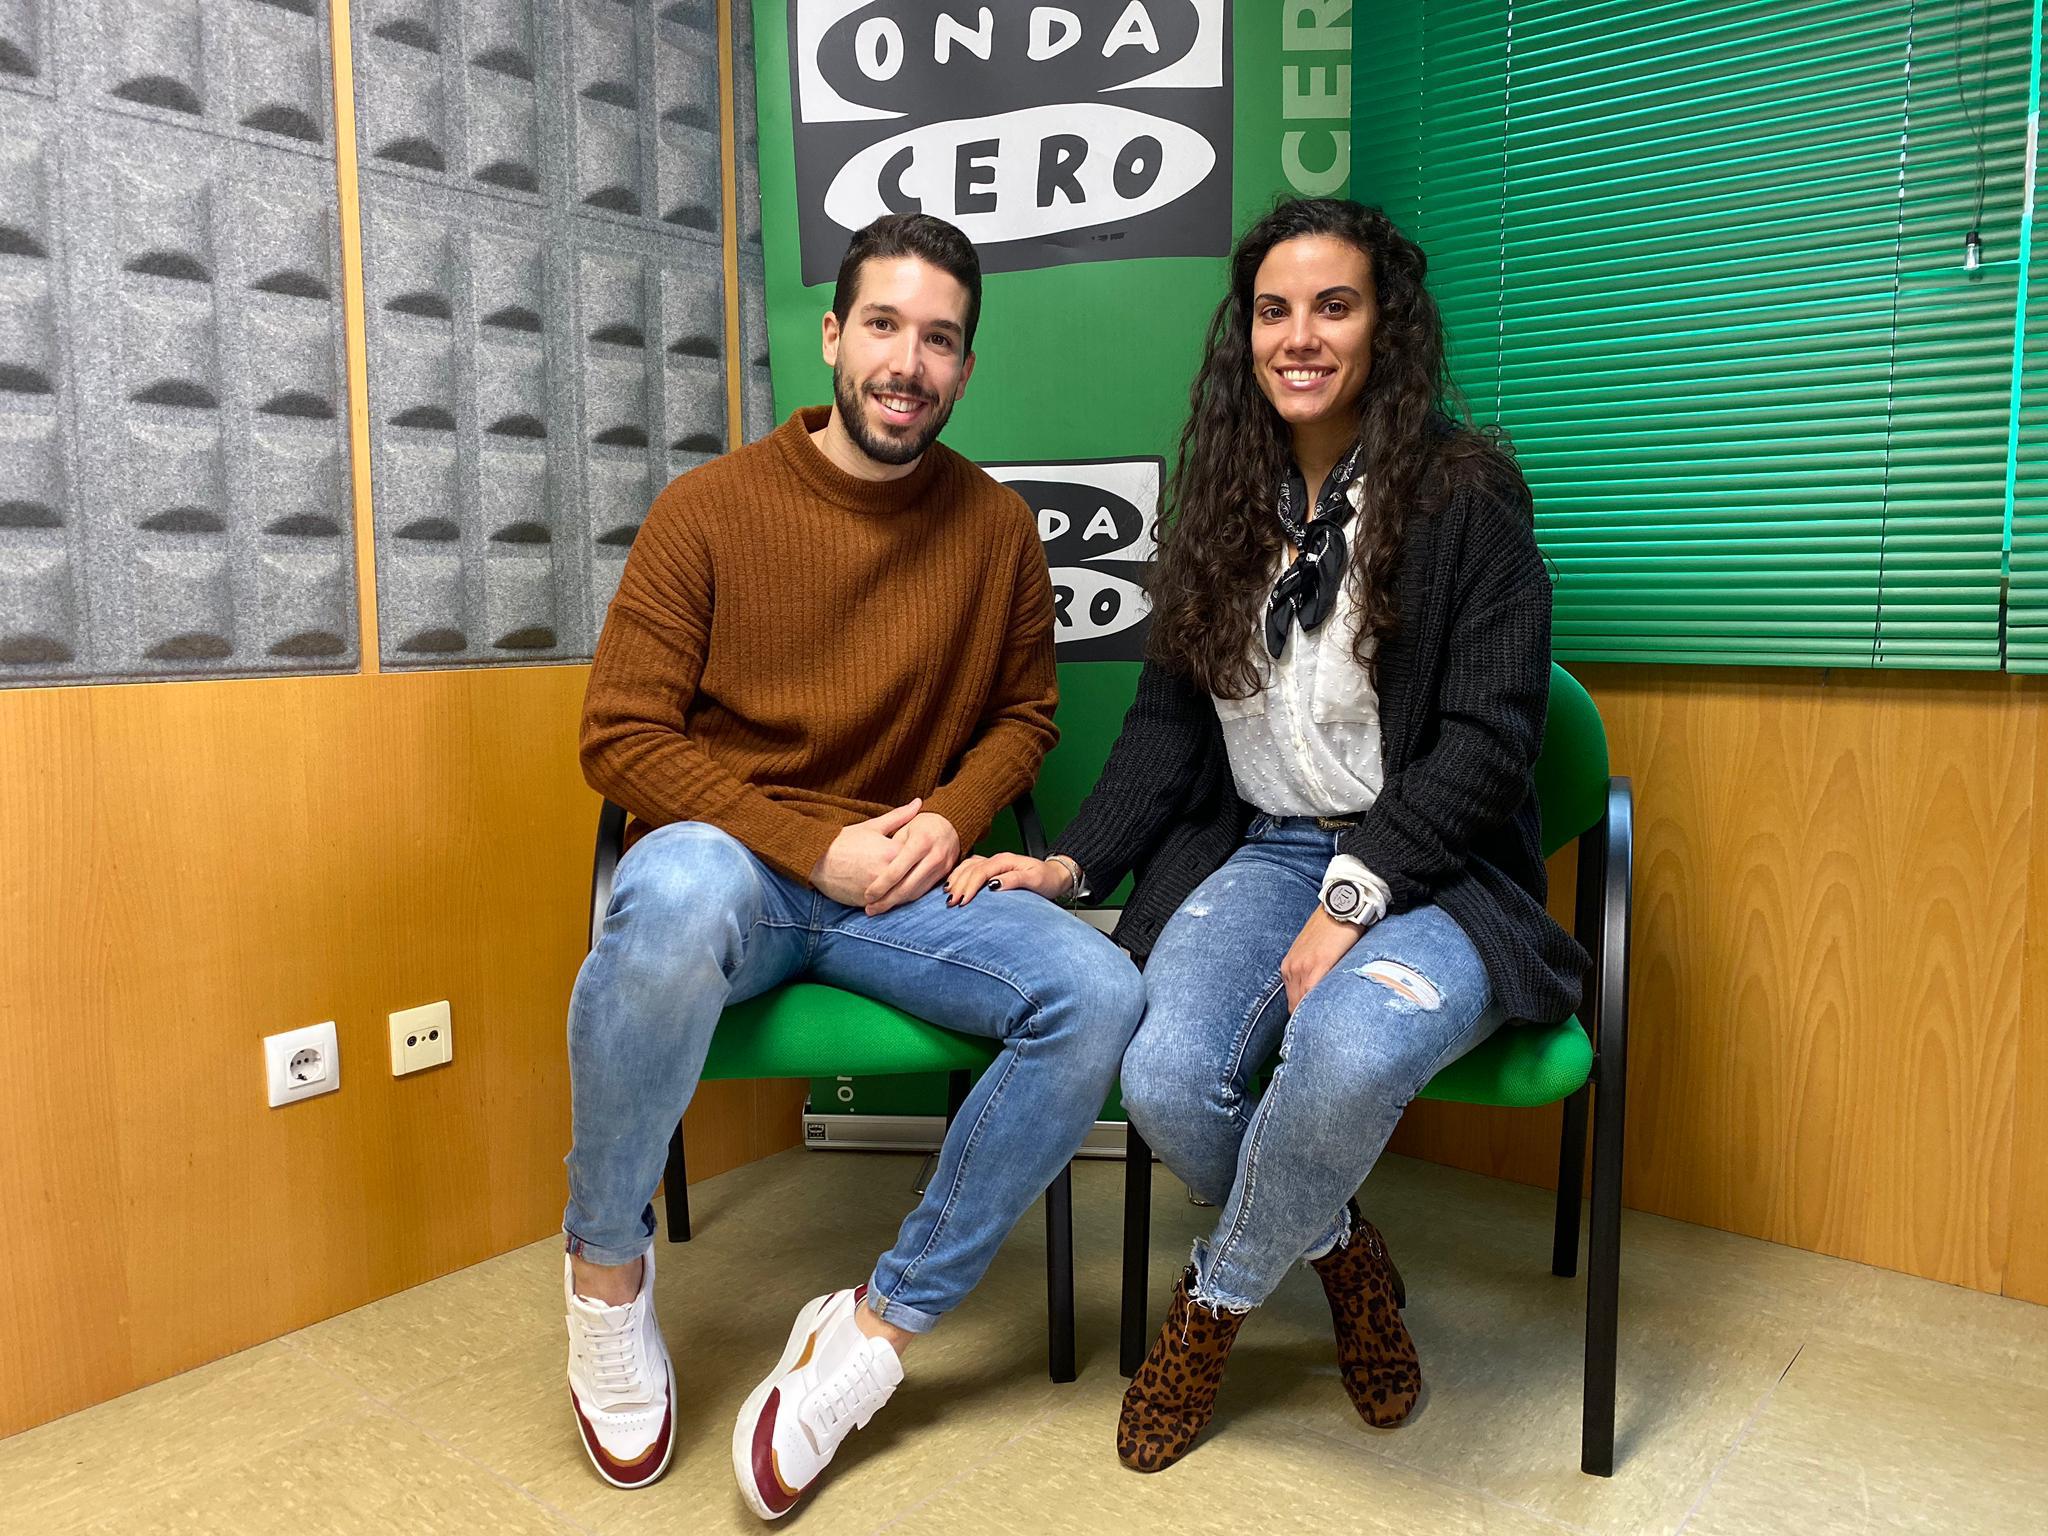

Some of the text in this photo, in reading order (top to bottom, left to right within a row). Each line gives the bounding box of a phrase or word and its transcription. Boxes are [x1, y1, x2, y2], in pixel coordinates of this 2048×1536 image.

[855, 0, 1160, 81] ONDA
[878, 134, 1163, 214] CERO
[1038, 506, 1119, 541] DA
[1054, 585, 1121, 627] RO
